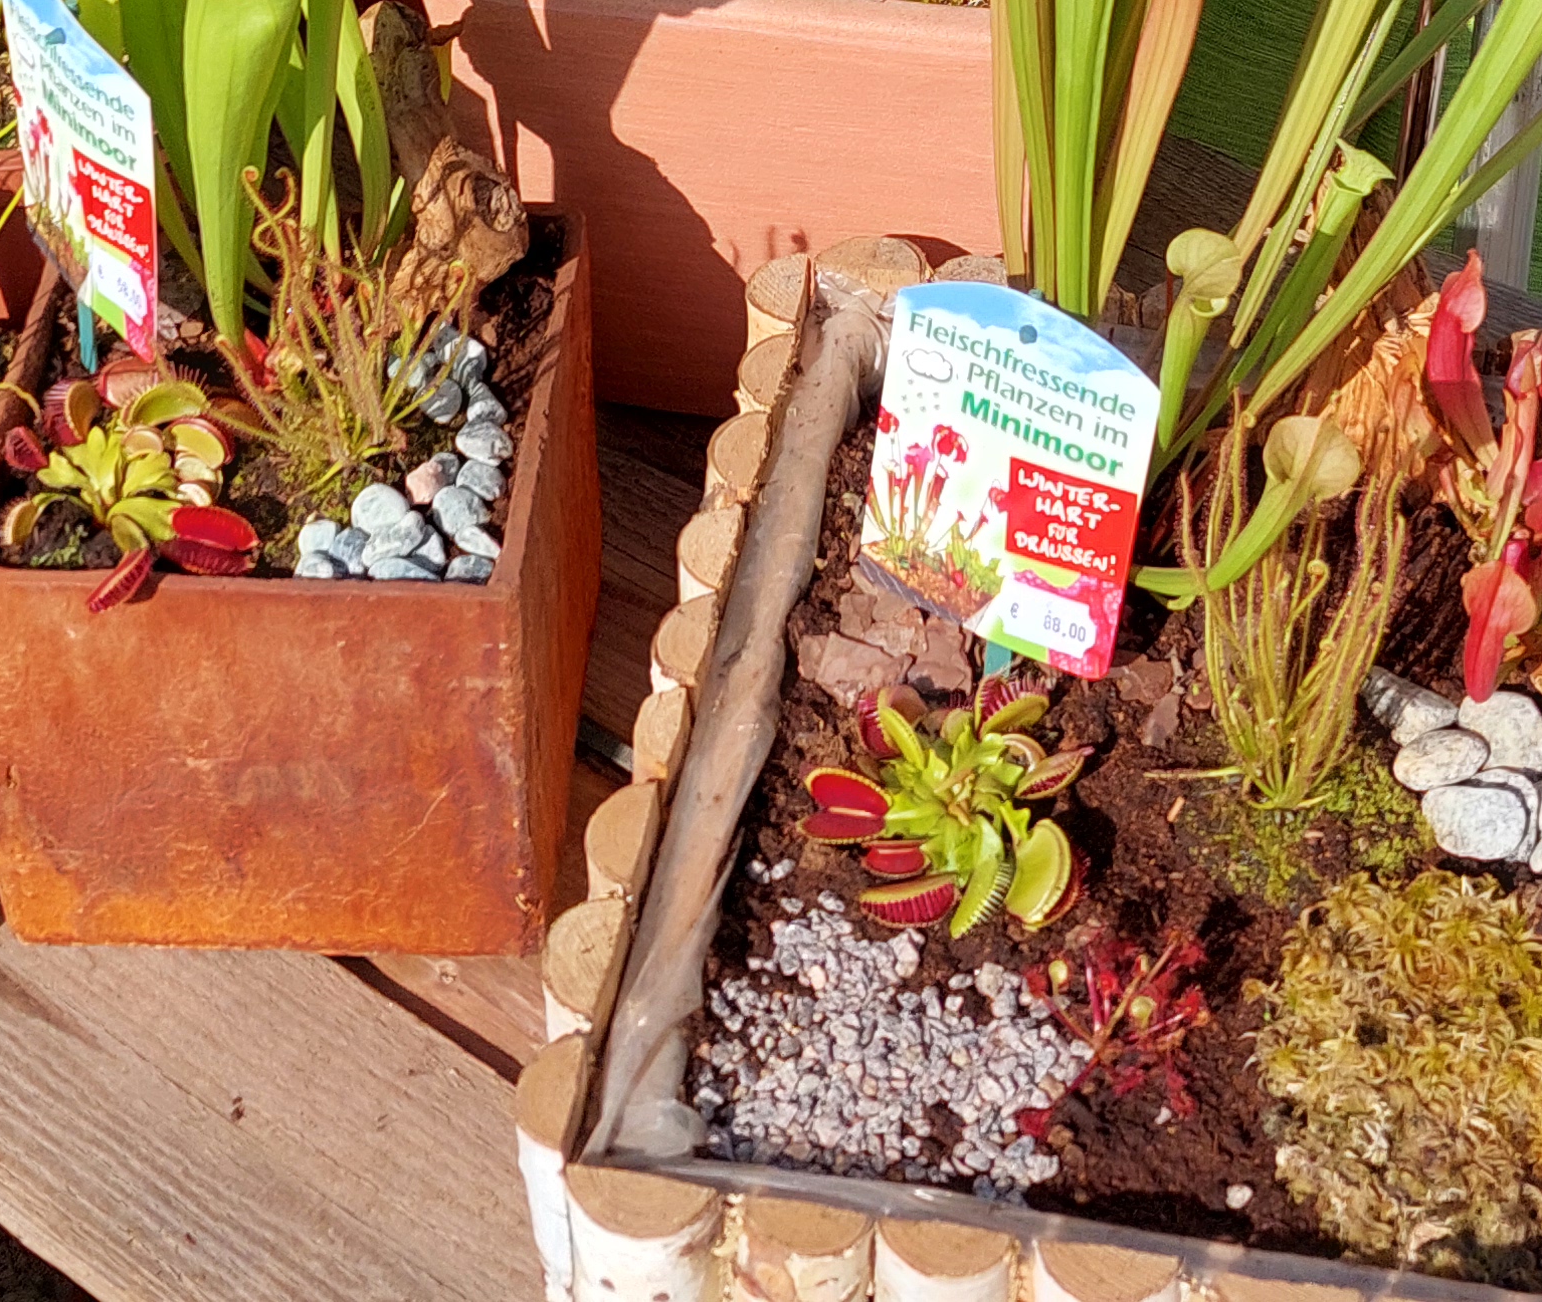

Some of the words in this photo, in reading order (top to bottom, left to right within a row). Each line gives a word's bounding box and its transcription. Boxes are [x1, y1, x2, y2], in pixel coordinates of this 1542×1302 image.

[909, 312, 1136, 421] Fleischfressende
[961, 390, 1124, 477] Minimoor
[967, 362, 1083, 431] Pflanzen
[1094, 416, 1129, 448] im
[1018, 468, 1121, 512] WINTER-
[1035, 496, 1102, 529] HART
[1014, 531, 1117, 576] DRAUSSEN!
